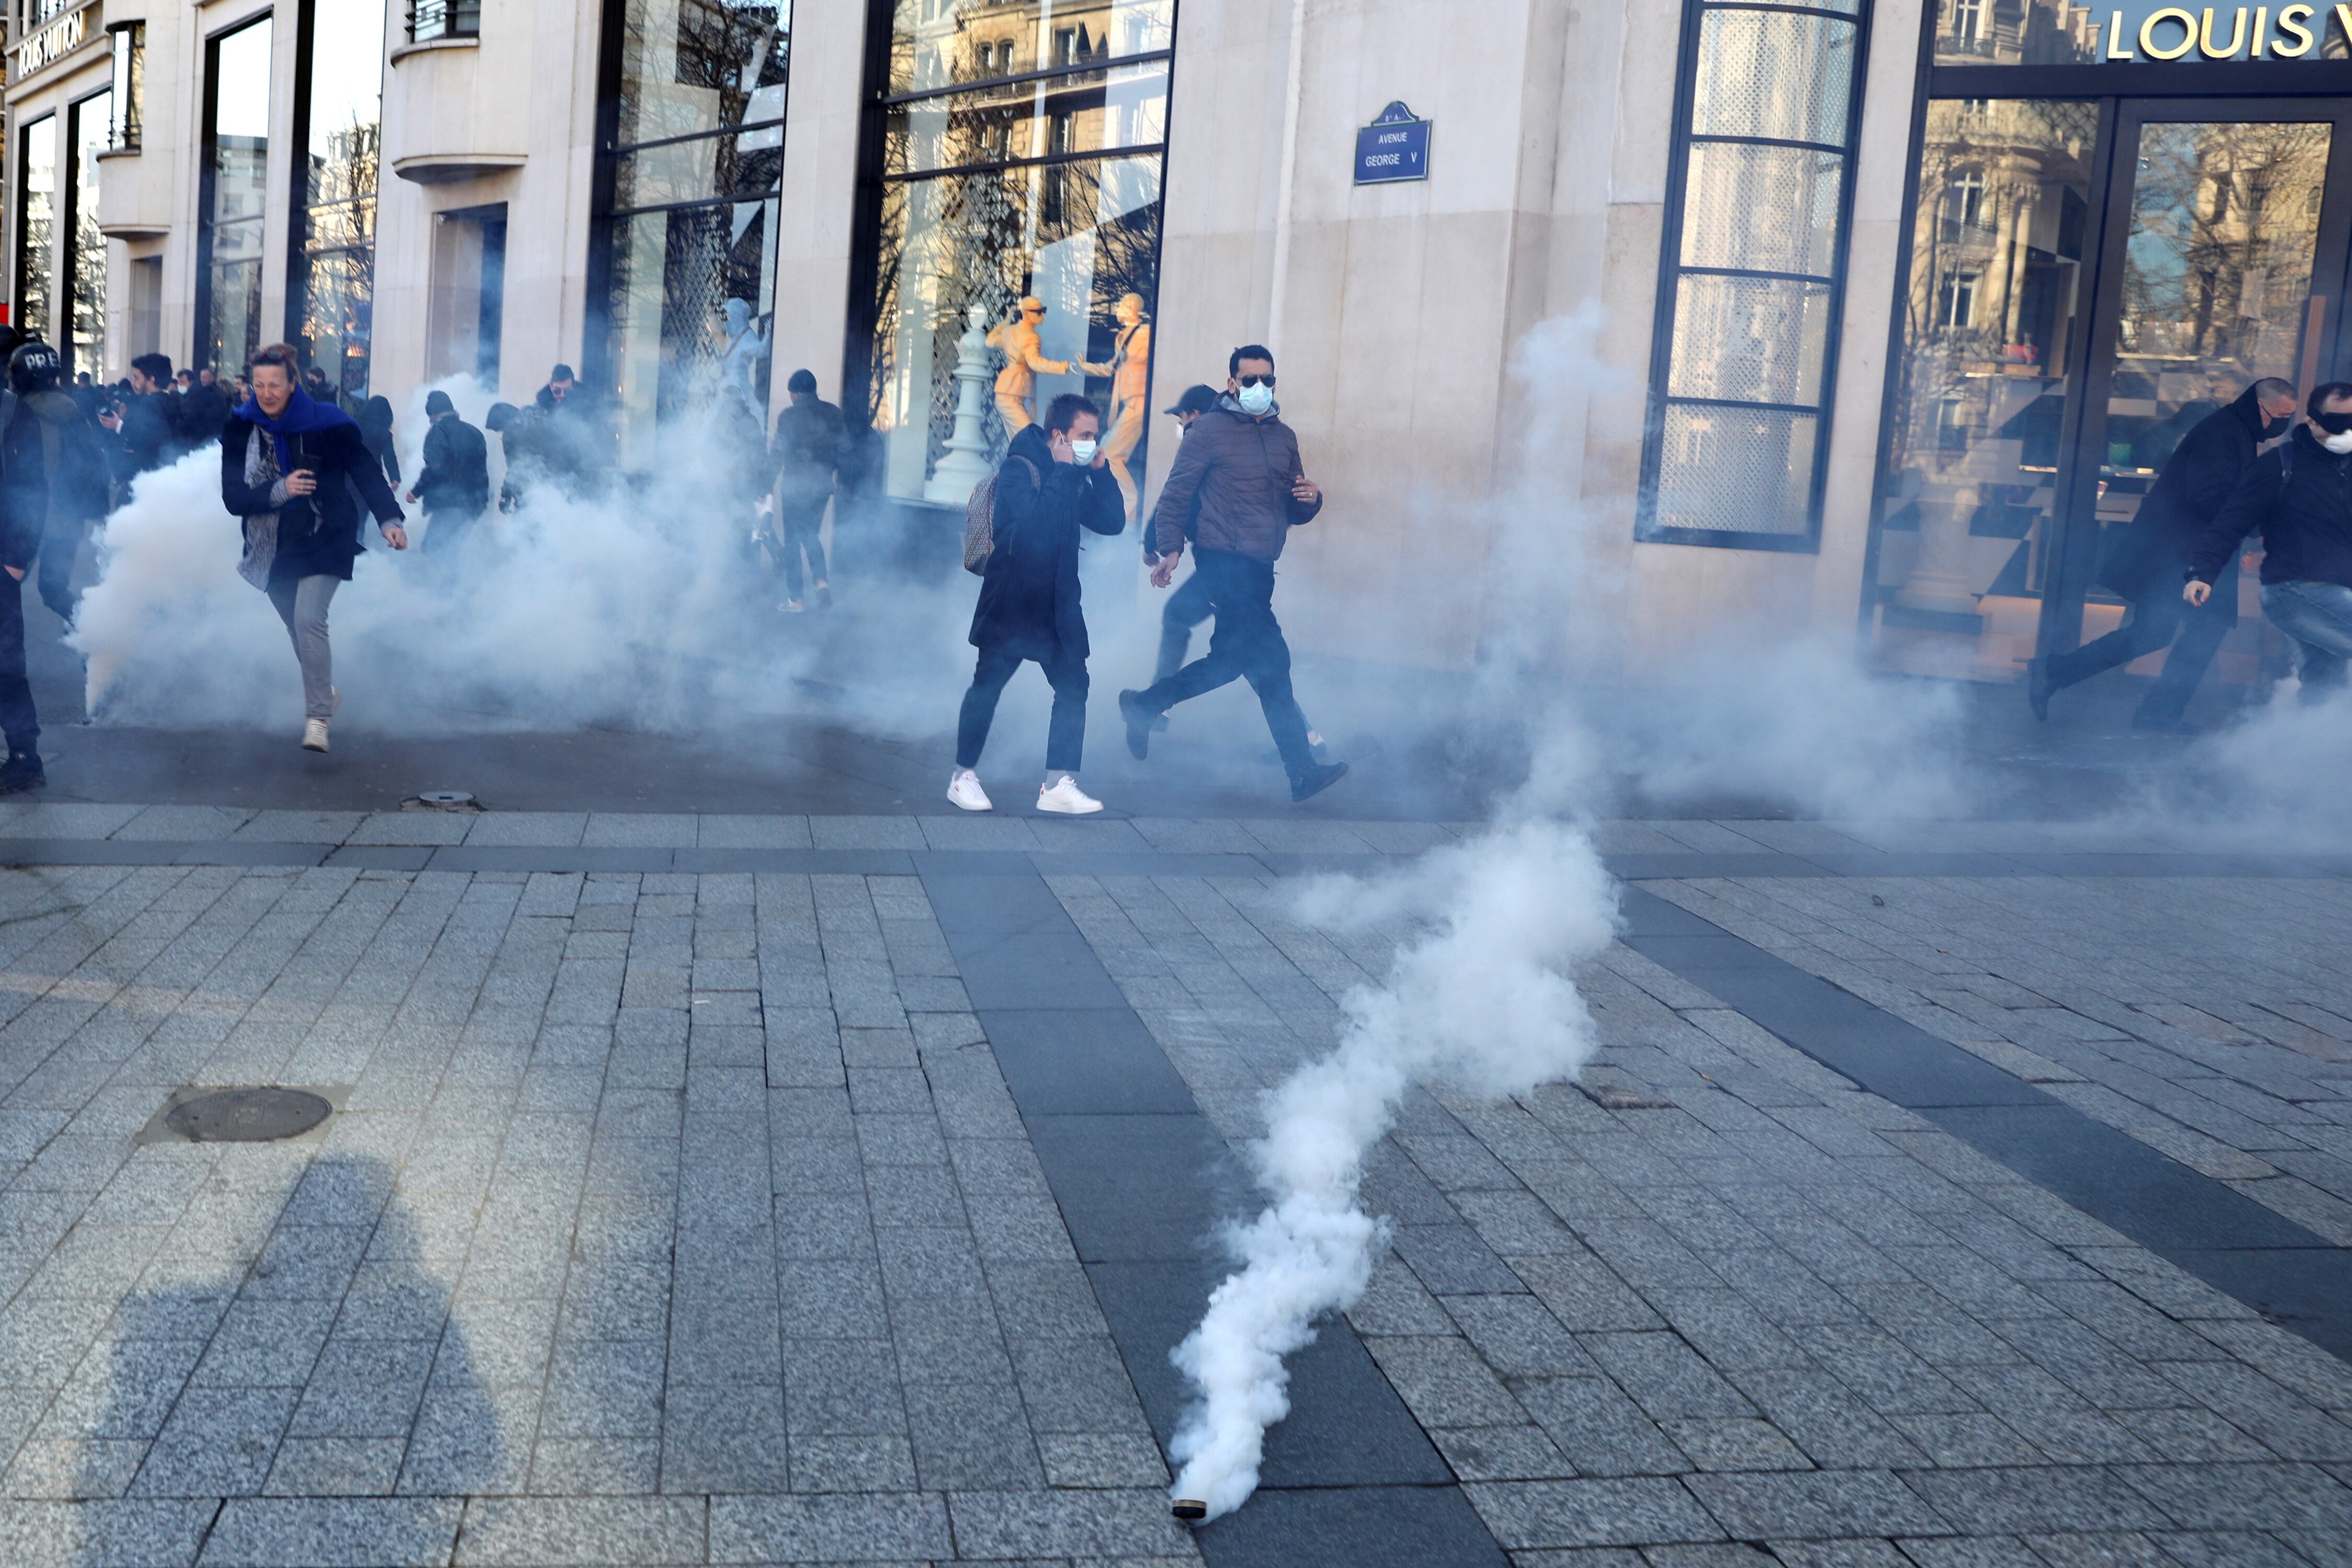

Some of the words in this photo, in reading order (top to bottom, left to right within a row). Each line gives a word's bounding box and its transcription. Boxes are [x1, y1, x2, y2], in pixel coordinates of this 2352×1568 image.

[2107, 4, 2315, 60] LOUIS
[18, 33, 43, 79] LOUIS
[43, 9, 85, 63] VUITTON
[1378, 132, 1408, 144] AVENUE
[1365, 153, 1400, 167] GEORGE
[1410, 152, 1417, 163] V
[25, 352, 60, 371] PRE
